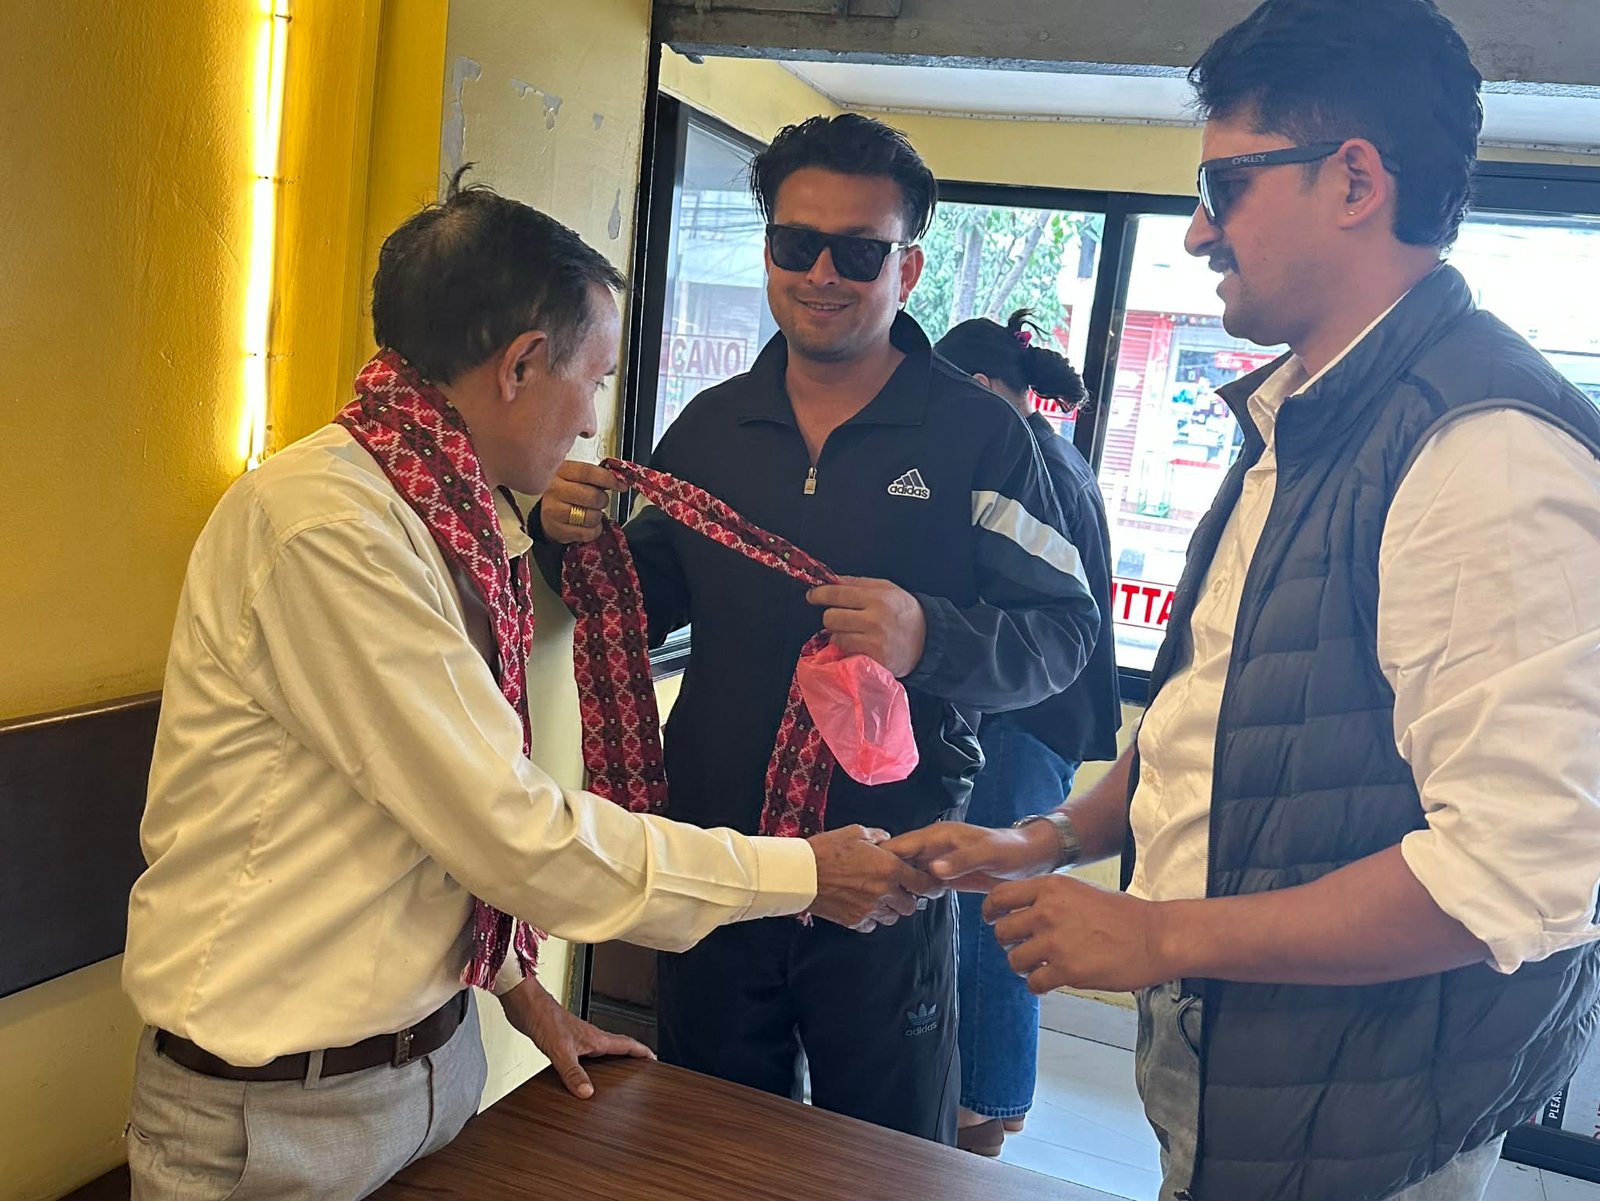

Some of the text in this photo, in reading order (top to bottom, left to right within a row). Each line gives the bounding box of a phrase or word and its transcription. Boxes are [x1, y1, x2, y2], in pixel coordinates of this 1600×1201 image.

[1231, 153, 1267, 166] OAKLEY
[888, 484, 930, 499] adidas
[905, 1021, 938, 1037] adidas
[1548, 1087, 1564, 1120] PLEAS
